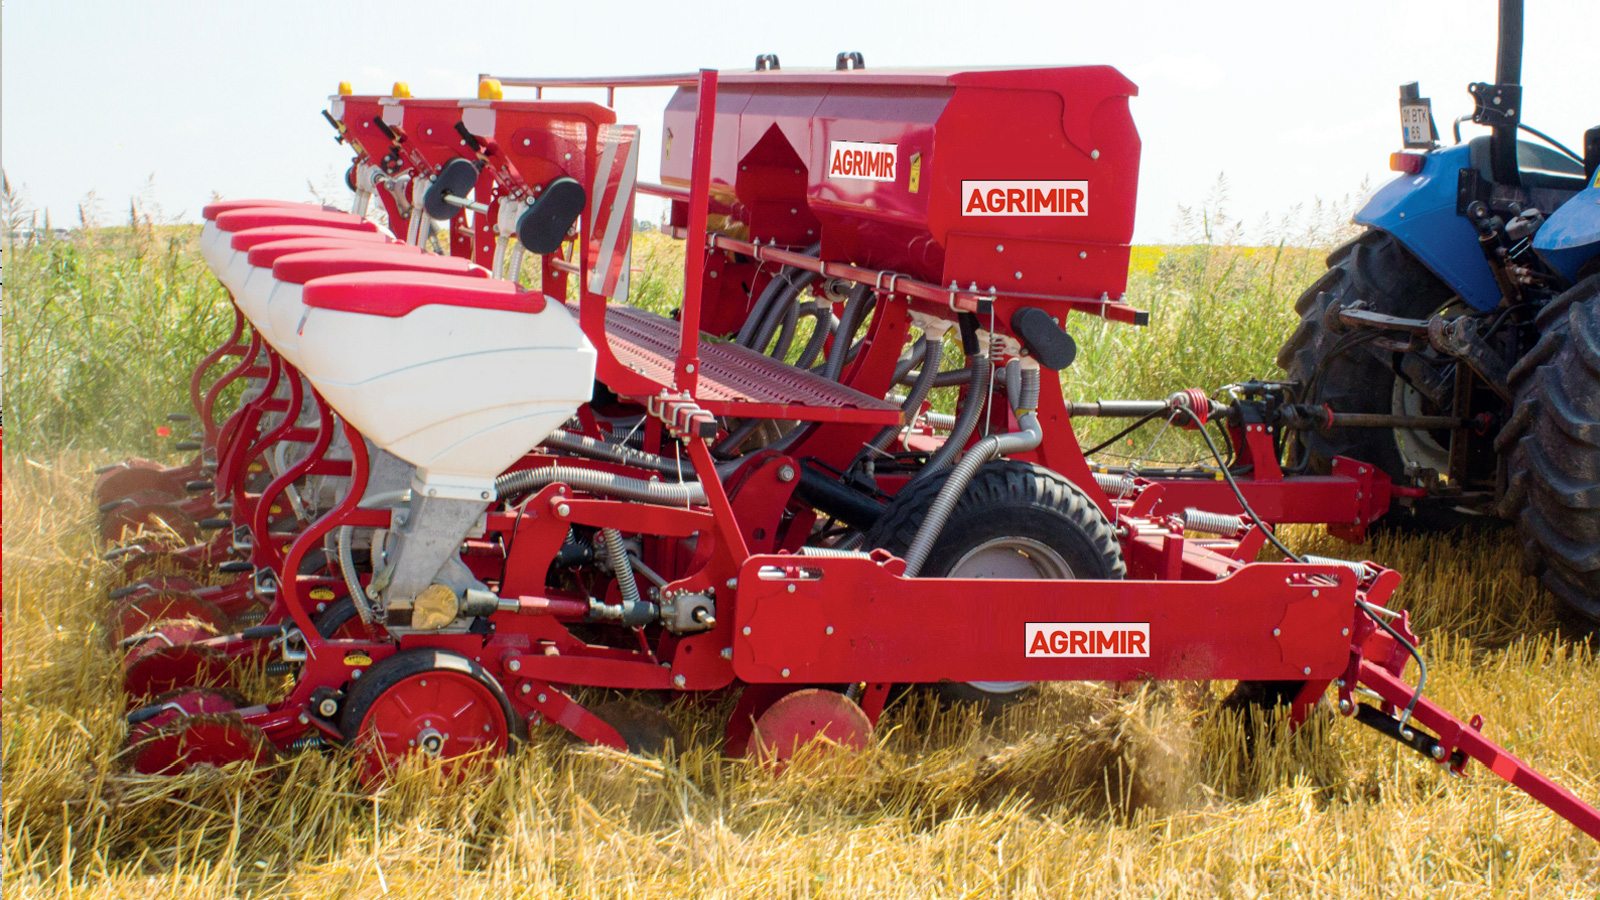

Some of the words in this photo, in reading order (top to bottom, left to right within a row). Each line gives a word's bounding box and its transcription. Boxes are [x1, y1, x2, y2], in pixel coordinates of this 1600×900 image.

[830, 149, 895, 179] AGRIMIR
[965, 188, 1086, 213] AGRIMIR
[1028, 630, 1147, 654] AGRIMIR
